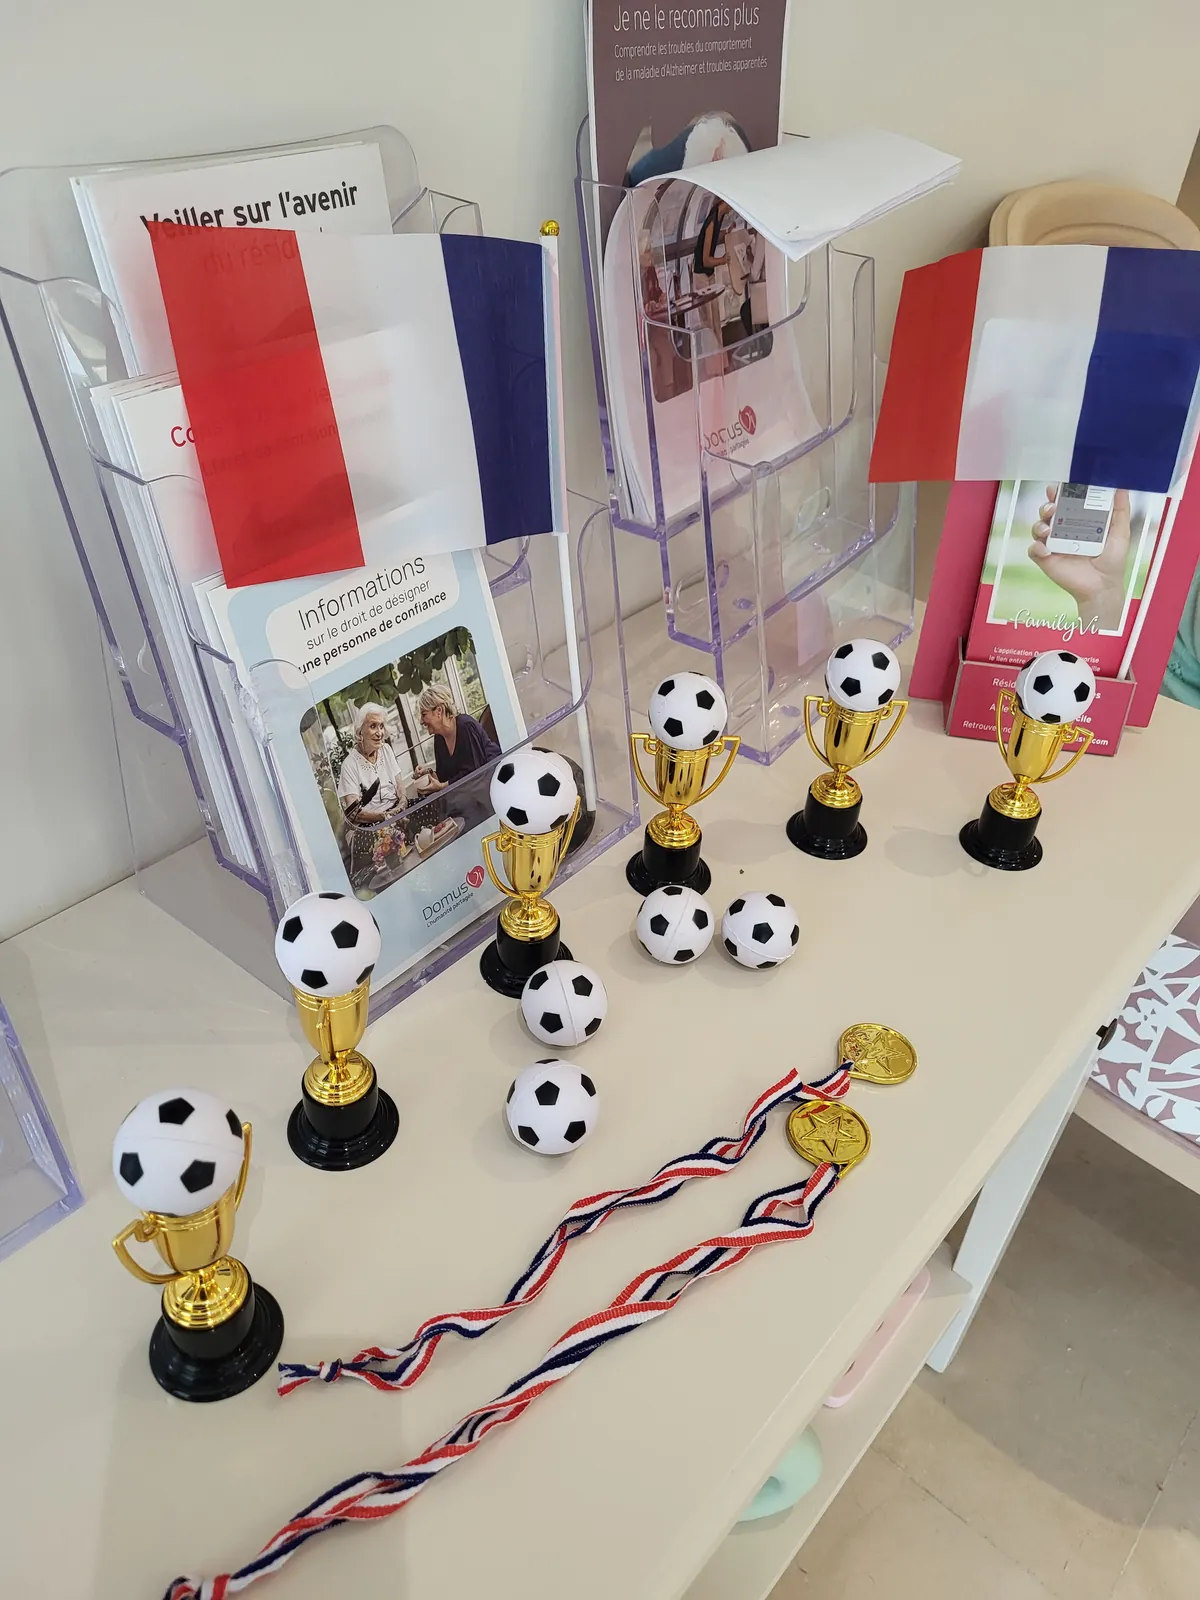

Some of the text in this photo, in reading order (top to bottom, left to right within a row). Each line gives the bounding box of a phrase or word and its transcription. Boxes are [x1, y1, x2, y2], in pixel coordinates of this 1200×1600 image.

[613, 1, 760, 32] Je ne le reconnais plus
[614, 36, 752, 59] Comprendre les troubles du comportement
[615, 55, 768, 81] de la maladie d'Alzheimer et troubles apparentés
[233, 199, 272, 227] sur
[278, 180, 358, 219] l'avenir
[297, 556, 426, 632] Informations
[306, 578, 431, 651] sur le droit de désigner
[1010, 608, 1099, 642] FamilyVi
[299, 590, 447, 675] une personne de confiance
[993, 646, 1033, 657] L'application
[995, 655, 1008, 663] lien
[1008, 657, 1026, 665] entre
